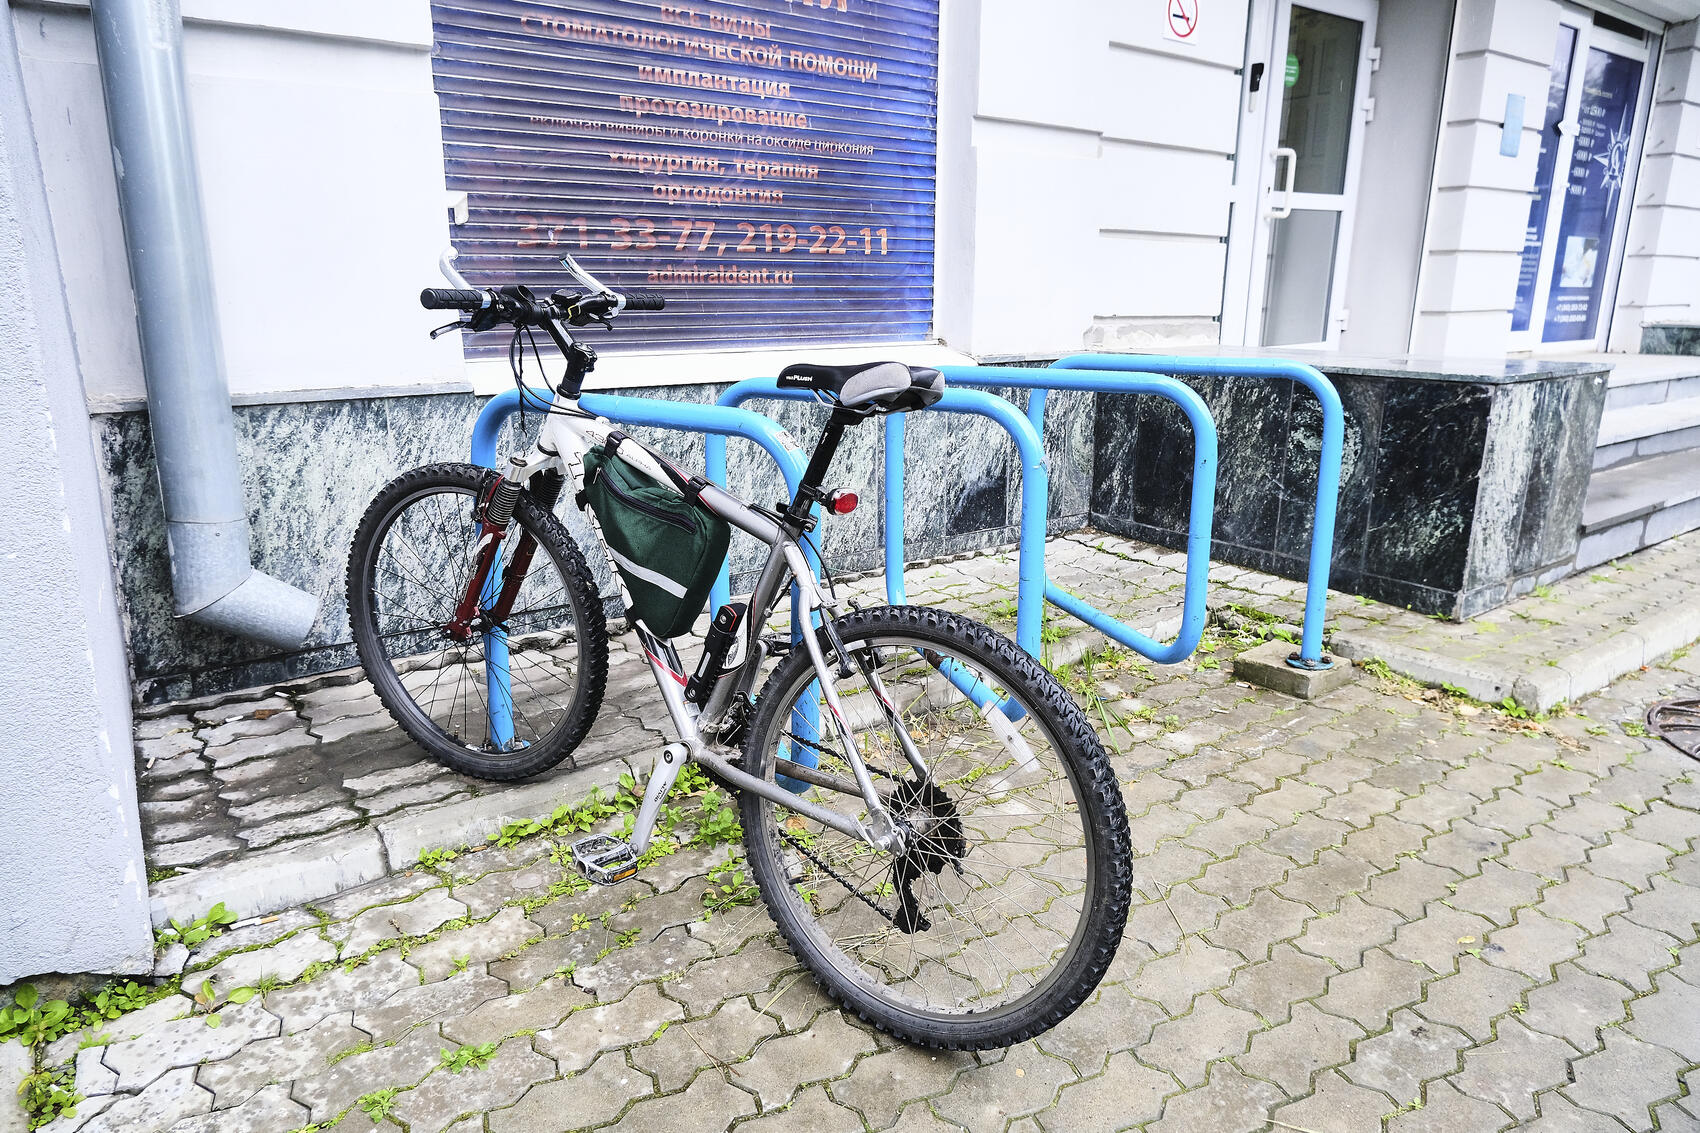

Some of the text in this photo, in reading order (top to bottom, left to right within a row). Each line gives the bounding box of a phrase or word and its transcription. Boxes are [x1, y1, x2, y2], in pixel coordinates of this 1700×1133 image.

[709, 10, 771, 40] ВИДЫ
[520, 12, 878, 82] СТОМАТОЛОГИЧЕСКОЙ ПОМОЩИ
[638, 64, 791, 99] имплантация
[619, 95, 808, 129] протезирование
[682, 127, 744, 147] коронки
[746, 133, 762, 146] на
[765, 135, 811, 151] оксиде
[813, 140, 874, 156] циркония
[735, 157, 819, 181] терапия
[653, 184, 784, 206] ортодонтия
[515, 214, 889, 257] 371-33-77, 219-22-11
[646, 264, 794, 285] admiraldent.ru
